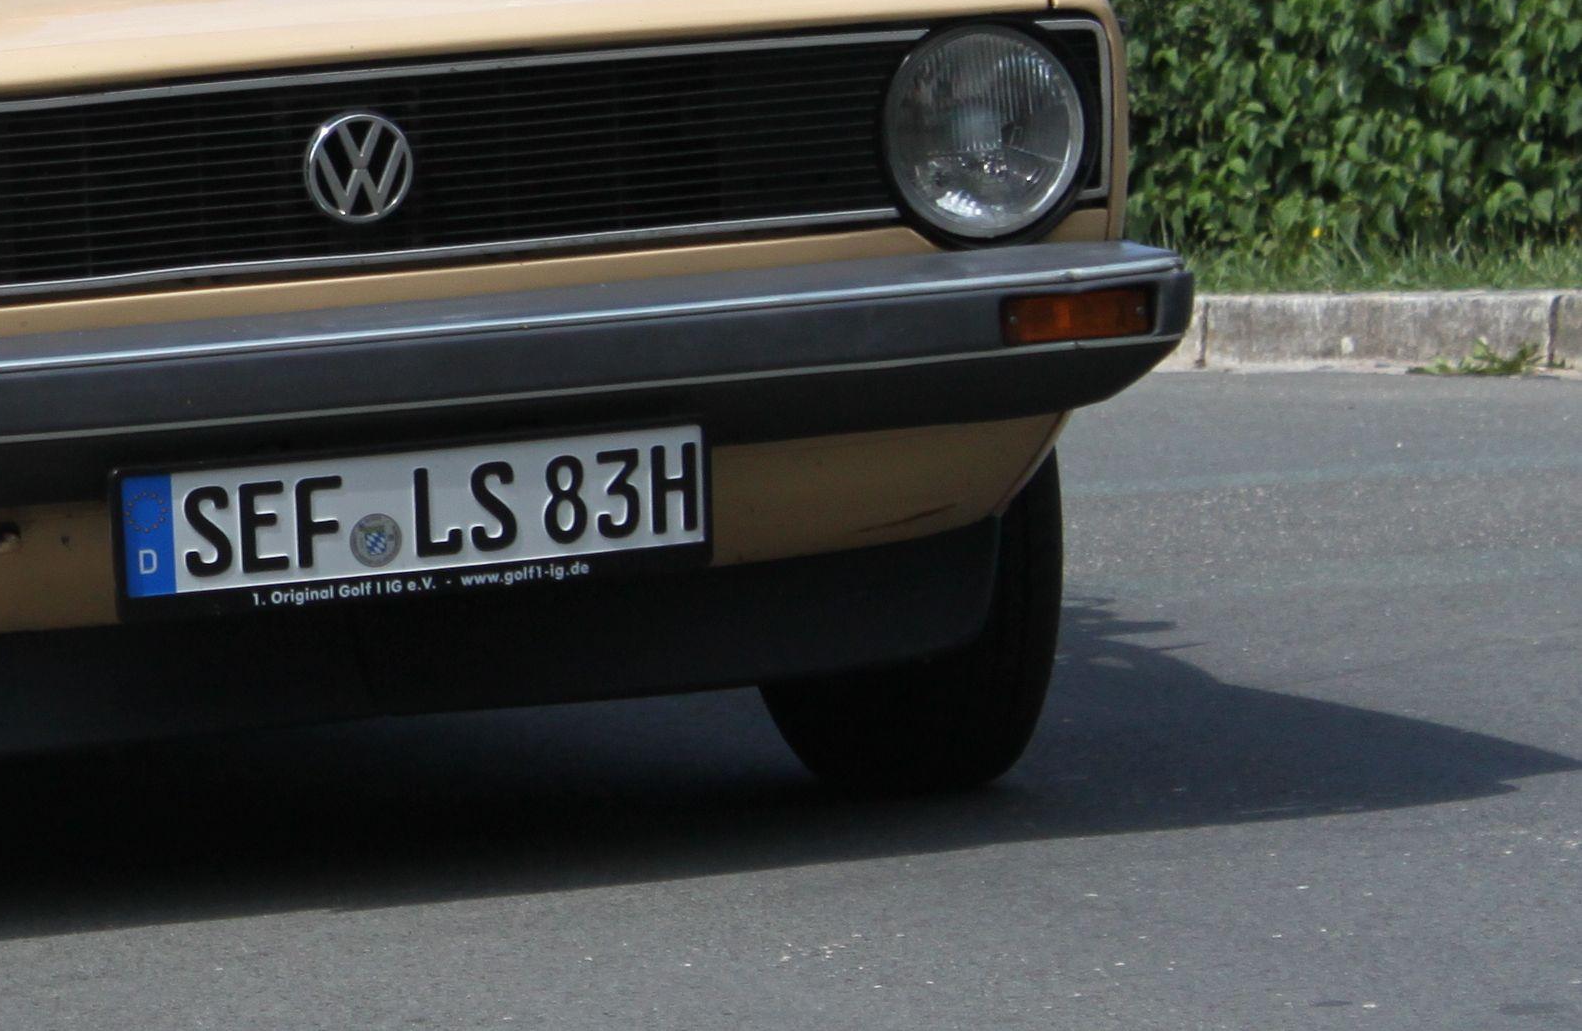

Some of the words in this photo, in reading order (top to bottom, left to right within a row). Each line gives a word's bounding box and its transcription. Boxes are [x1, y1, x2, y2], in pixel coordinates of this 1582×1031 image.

[306, 112, 414, 223] VW
[183, 475, 342, 578] SEF
[413, 460, 517, 553] LS
[543, 441, 698, 545] 83H
[138, 548, 158, 576] D
[252, 592, 267, 606] 1.
[271, 585, 334, 606] Original
[338, 581, 372, 599] Golf
[386, 579, 403, 594] IG
[407, 576, 437, 591] e.V.
[460, 561, 590, 586] www.golf1-ig.de
